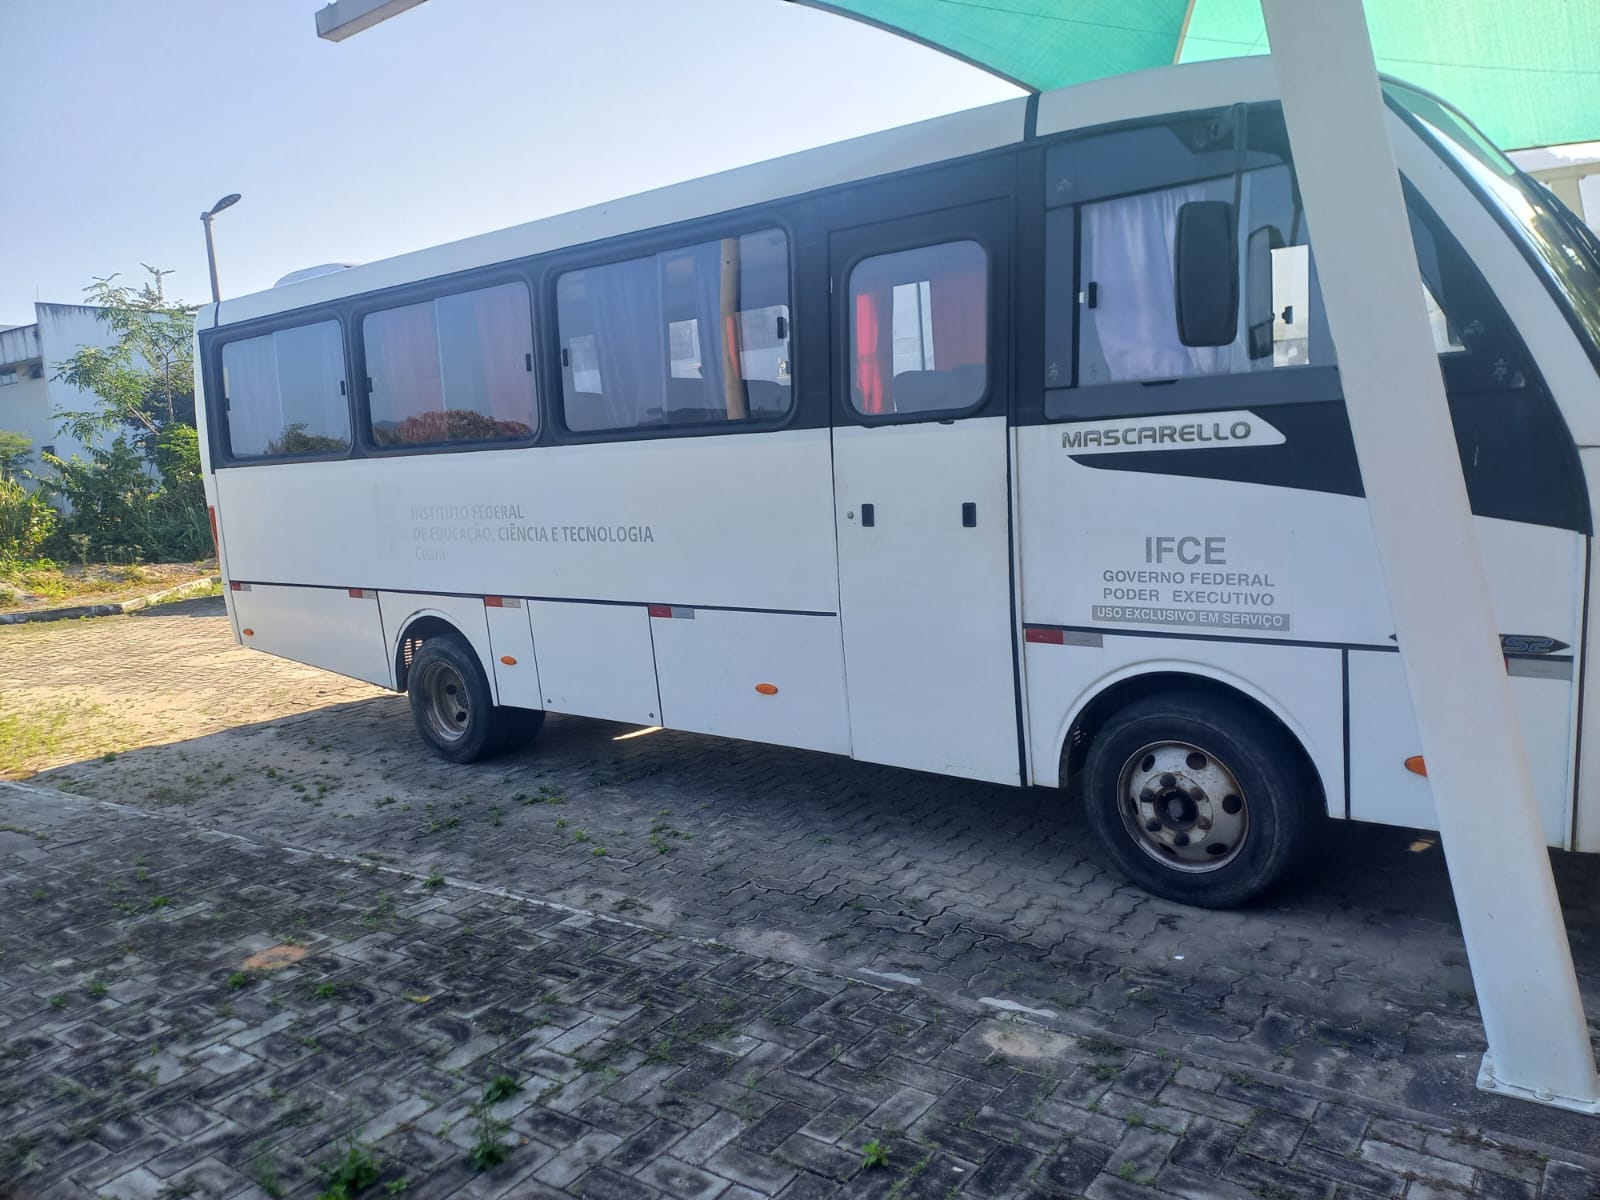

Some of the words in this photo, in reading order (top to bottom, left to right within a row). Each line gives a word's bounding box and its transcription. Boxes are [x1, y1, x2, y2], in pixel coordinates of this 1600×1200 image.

[1062, 421, 1251, 449] MASCARELLO
[411, 504, 469, 521] INSTITUTO
[472, 504, 524, 520] FEDERAL
[413, 527, 428, 541] DE
[430, 523, 495, 544] EDUCAÇÃO,
[498, 523, 548, 542] CIÊNCIA
[551, 527, 559, 542] E
[561, 526, 655, 543] TECNOLOGIA
[415, 546, 447, 561] Ceará
[1145, 536, 1227, 565] IFCE
[1103, 570, 1185, 584] GOVERNO
[1190, 572, 1275, 587] FEDERAL
[1103, 588, 1160, 602] PODER
[1172, 590, 1275, 607] EXECUTIVO
[1097, 607, 1122, 618] USO
[1125, 608, 1196, 622] EXCLUSIVO
[1199, 612, 1219, 624] EM
[1222, 613, 1283, 628] SERVIÇO
